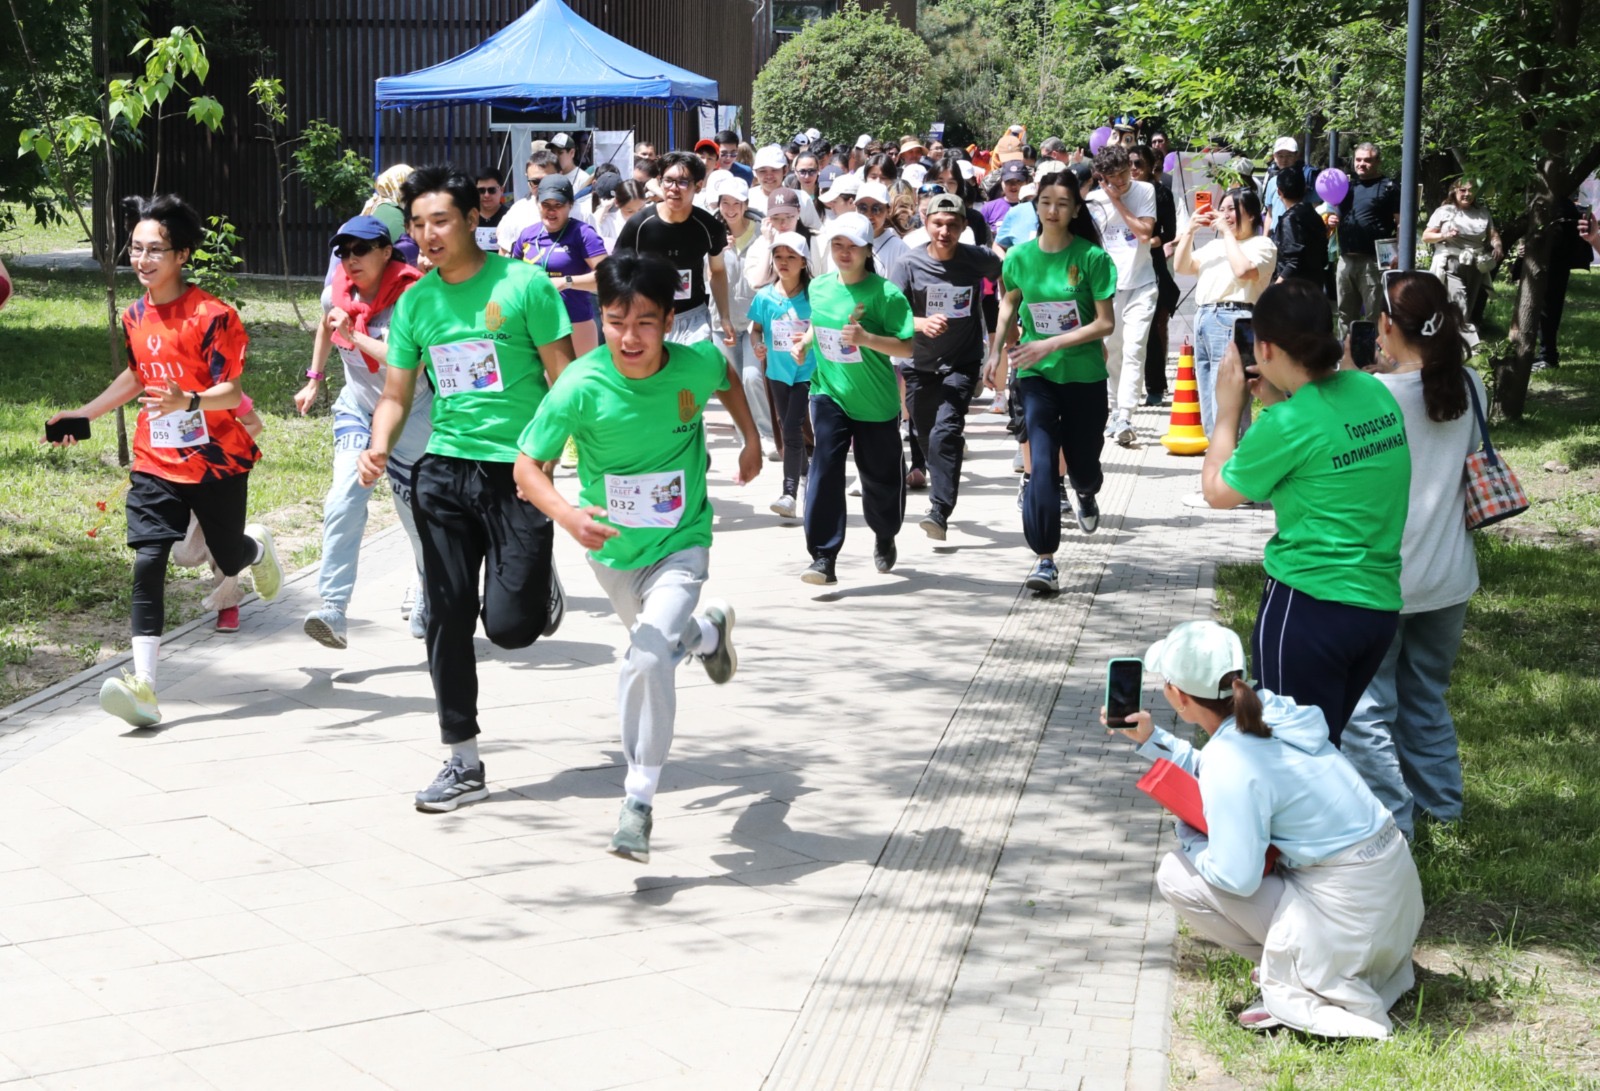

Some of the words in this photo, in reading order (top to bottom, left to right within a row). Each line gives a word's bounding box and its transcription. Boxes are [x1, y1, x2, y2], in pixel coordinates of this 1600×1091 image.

[1035, 321, 1049, 329] 047
[140, 361, 184, 379] SDU
[439, 378, 457, 388] 031
[1344, 412, 1398, 441] Городская
[152, 431, 170, 440] 059
[1331, 432, 1404, 470] поликлиника
[610, 498, 636, 511] 032
